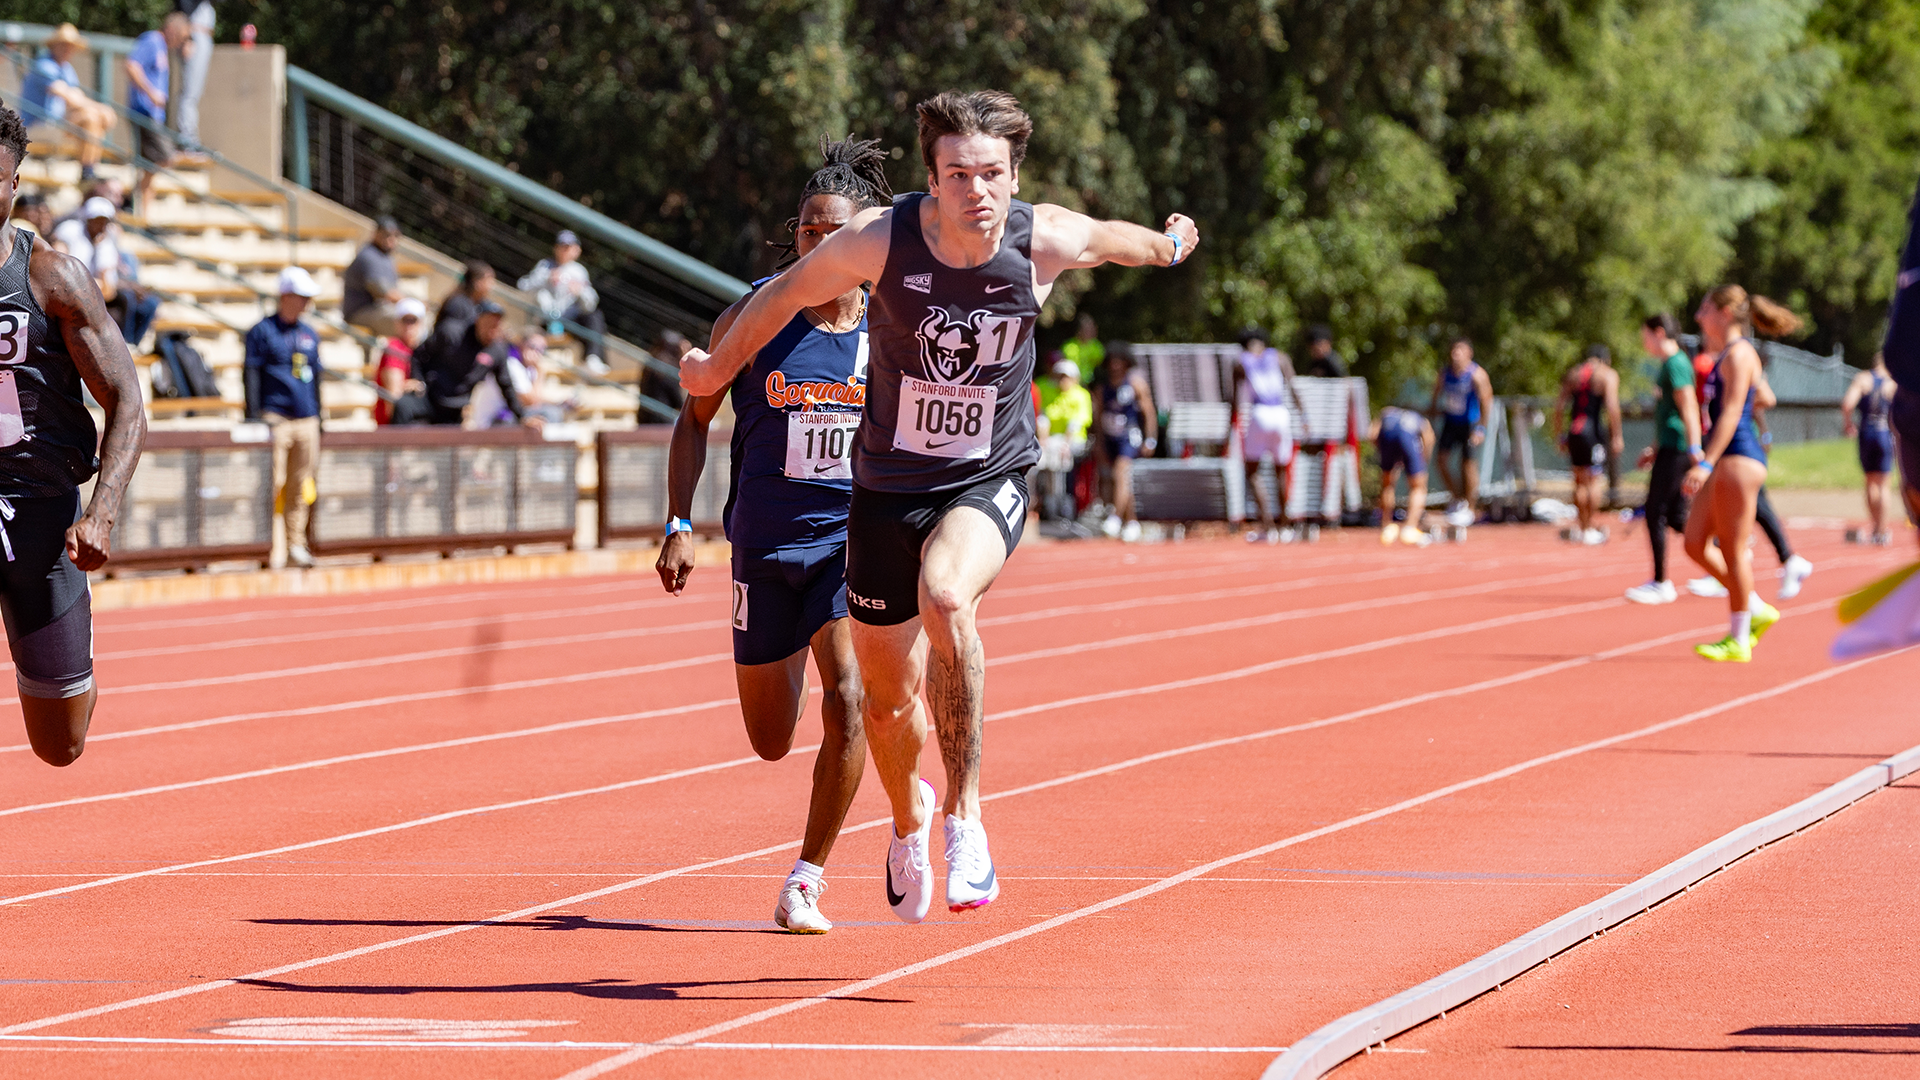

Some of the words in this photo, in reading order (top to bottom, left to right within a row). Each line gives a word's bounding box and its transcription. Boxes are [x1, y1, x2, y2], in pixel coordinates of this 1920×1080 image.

[0, 314, 19, 361] 3
[992, 321, 1008, 361] 1
[912, 380, 956, 397] STANFORD
[958, 386, 987, 399] INVITE
[800, 413, 839, 424] STANFORD
[915, 397, 983, 437] 1058
[805, 427, 859, 459] 1107
[734, 583, 743, 627] 2
